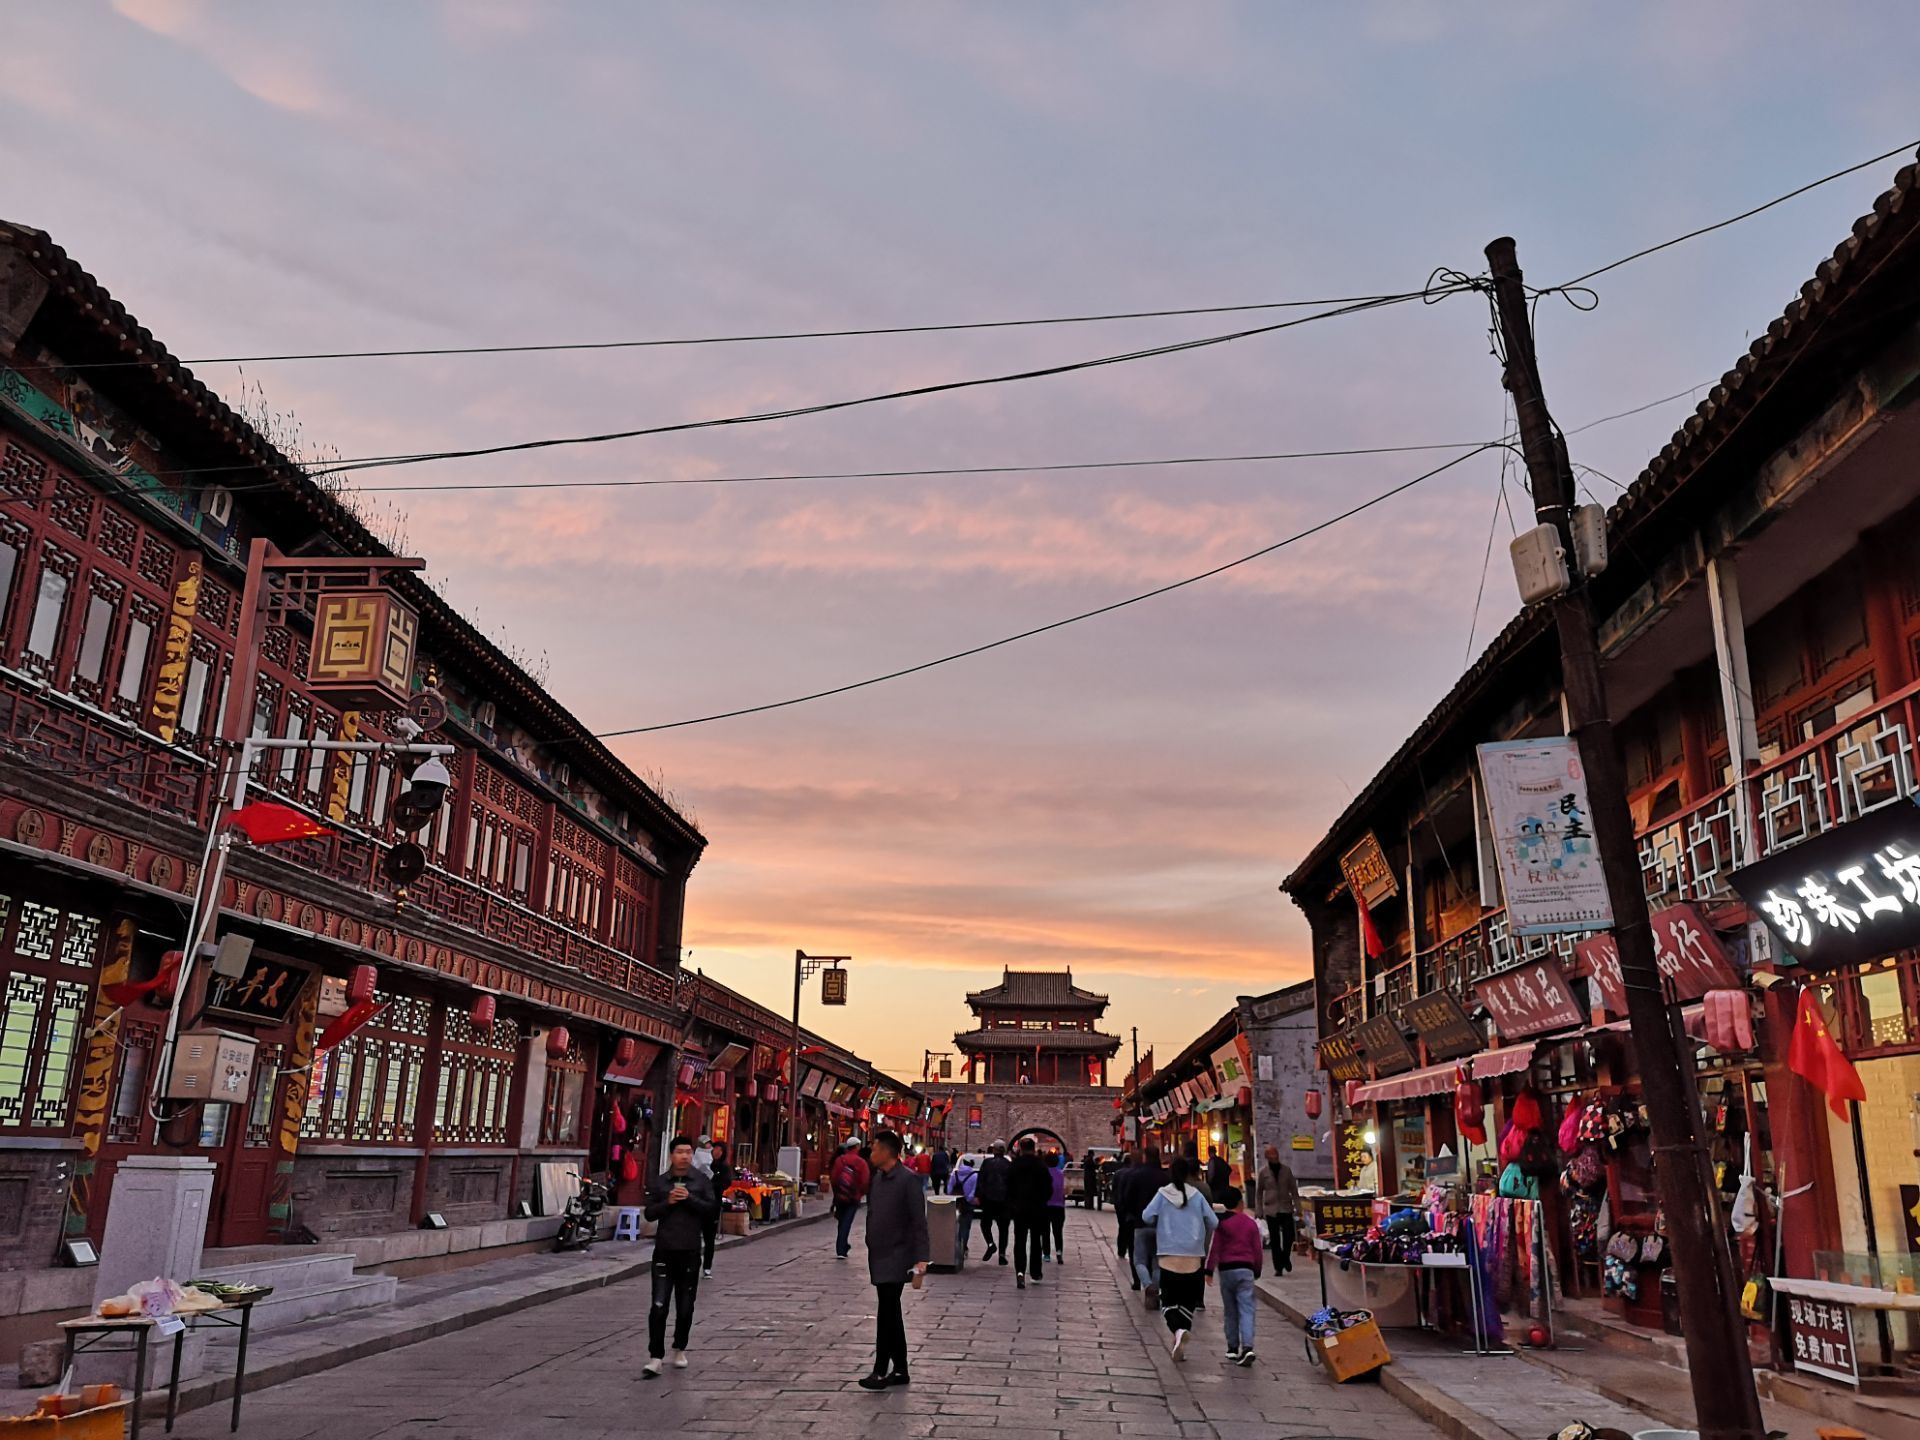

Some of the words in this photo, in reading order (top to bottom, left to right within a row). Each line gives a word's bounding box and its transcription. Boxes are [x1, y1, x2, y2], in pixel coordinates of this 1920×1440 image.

[1560, 793, 1592, 841] 民主
[1761, 846, 1920, 947] 珍珠工坊
[1789, 1299, 1845, 1335] 现场开蚌
[1794, 1331, 1851, 1368] 免费加工
